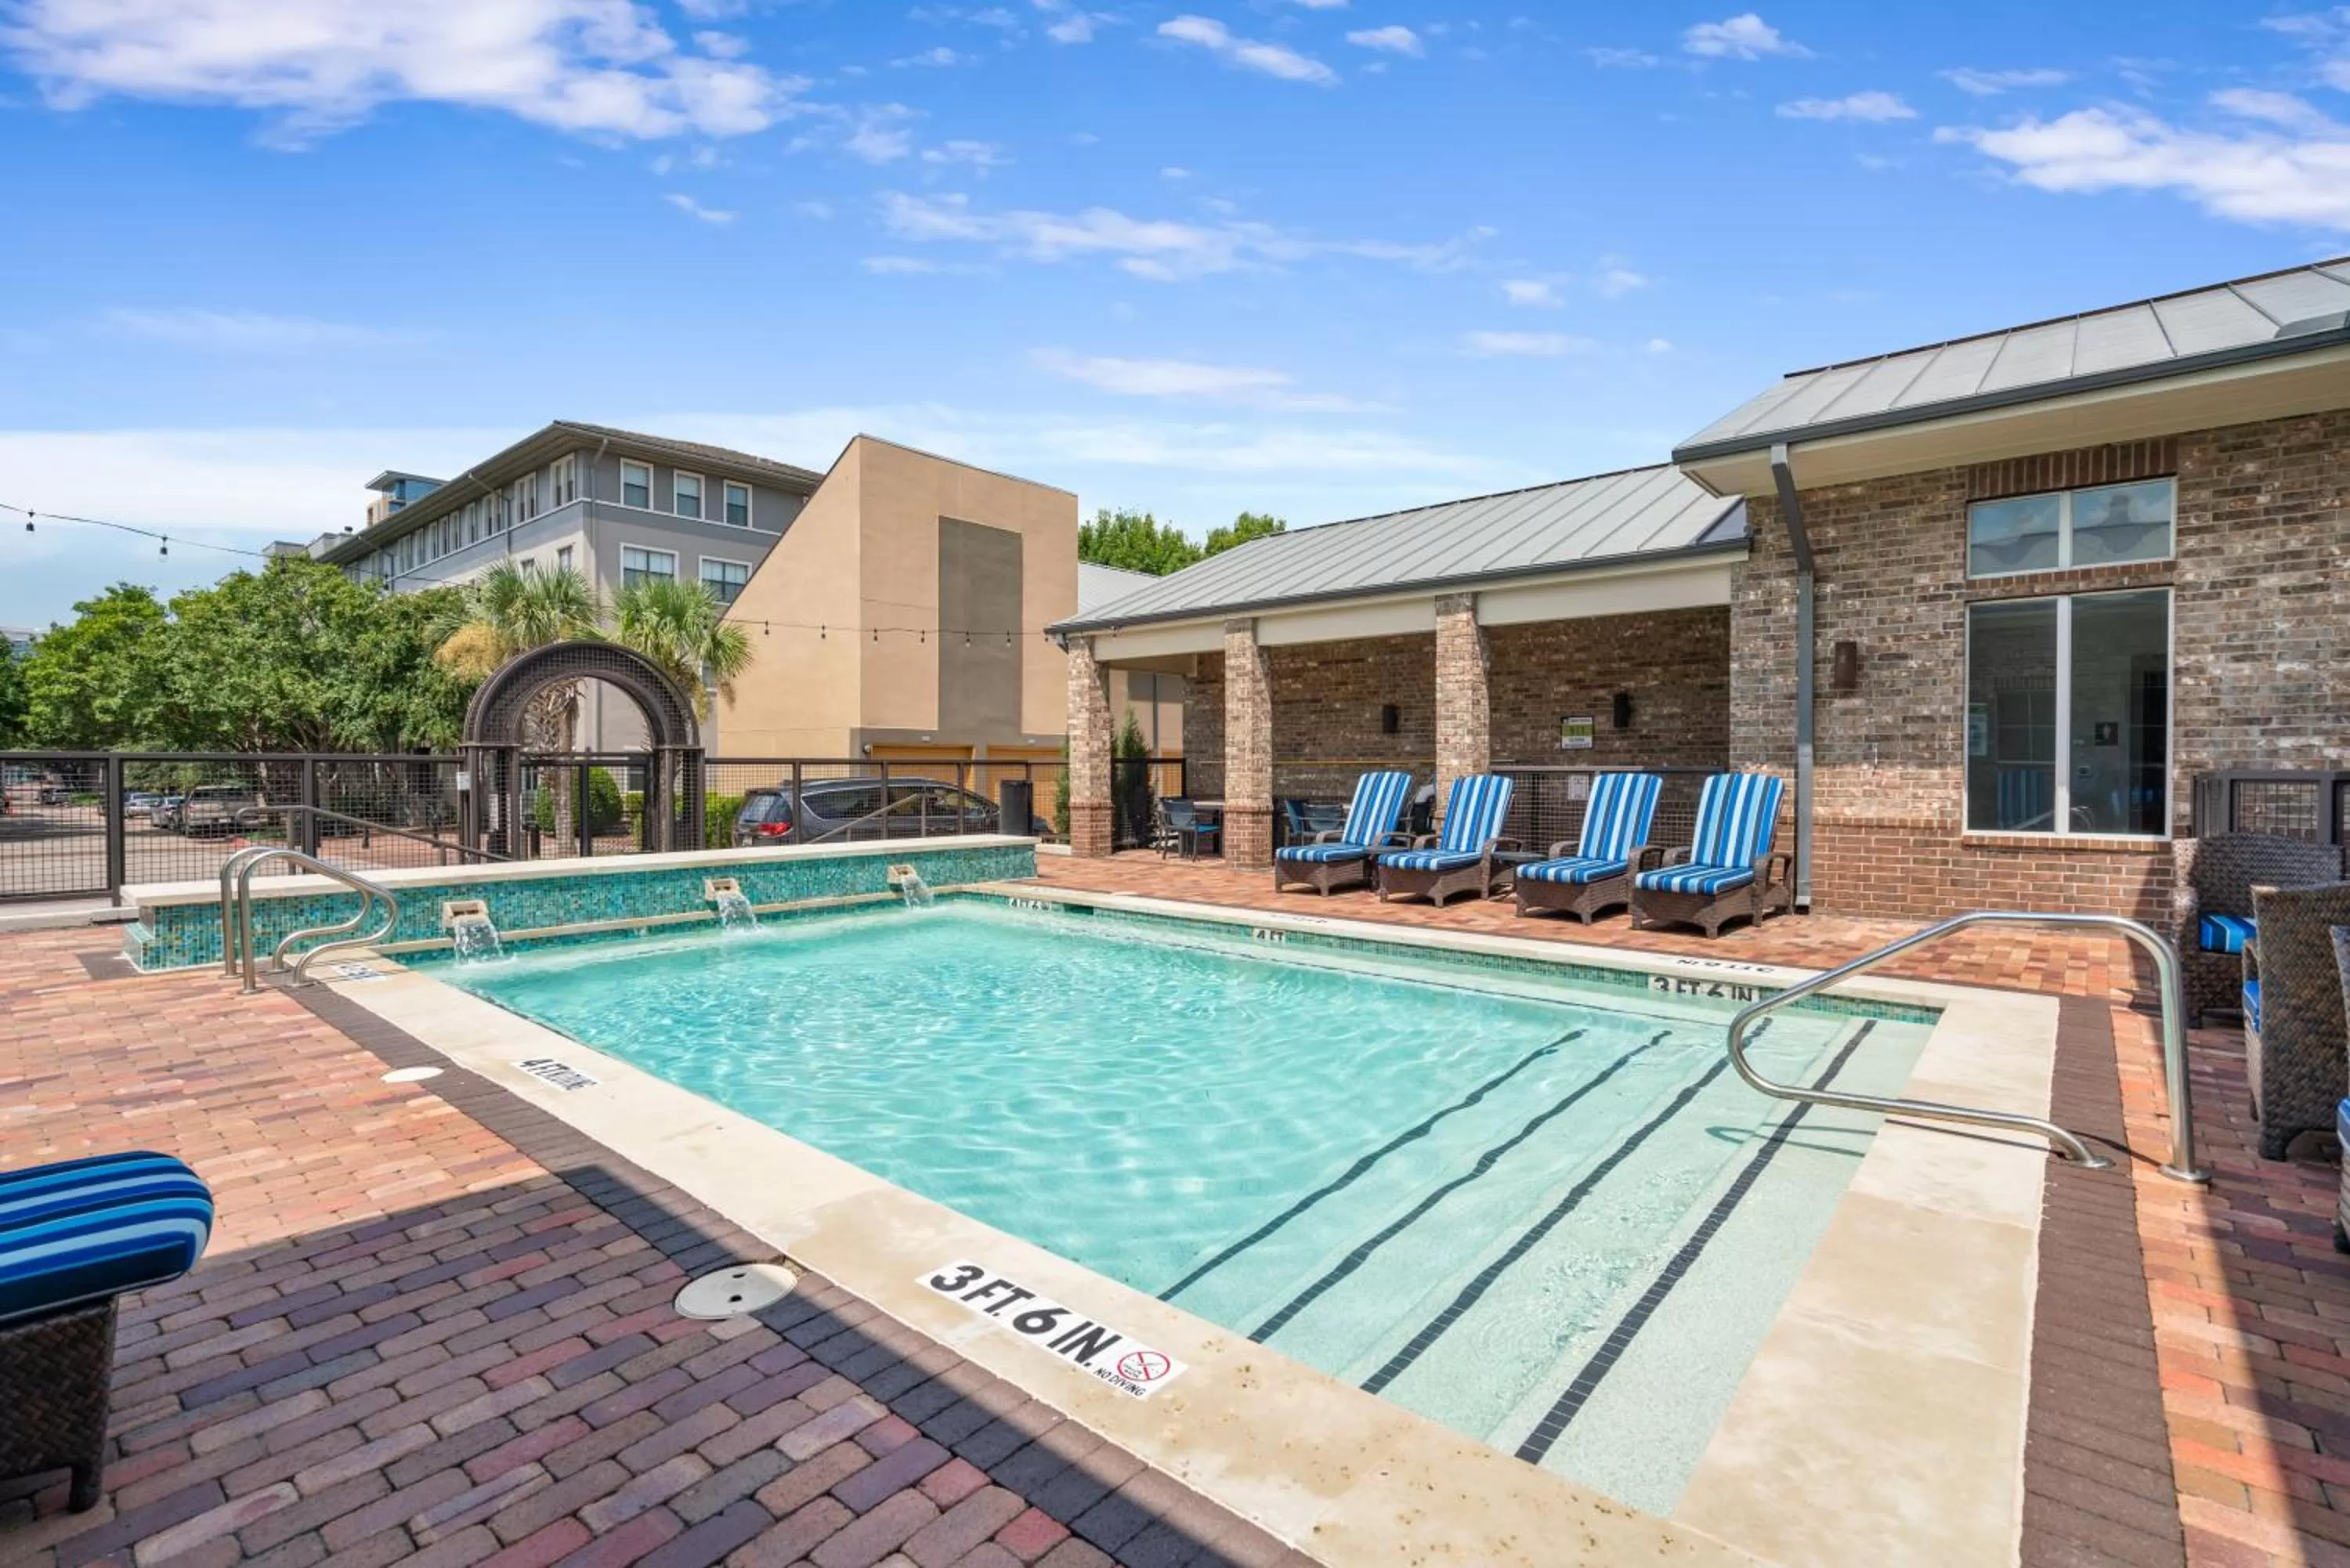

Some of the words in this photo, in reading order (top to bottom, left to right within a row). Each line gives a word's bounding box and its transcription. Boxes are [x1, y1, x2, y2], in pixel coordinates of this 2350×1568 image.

[1731, 986, 1752, 1002] IN
[930, 1265, 985, 1292] 3
[1012, 1307, 1072, 1335] 6
[1094, 1367, 1112, 1378] NO
[1108, 1375, 1147, 1396] DIVING
